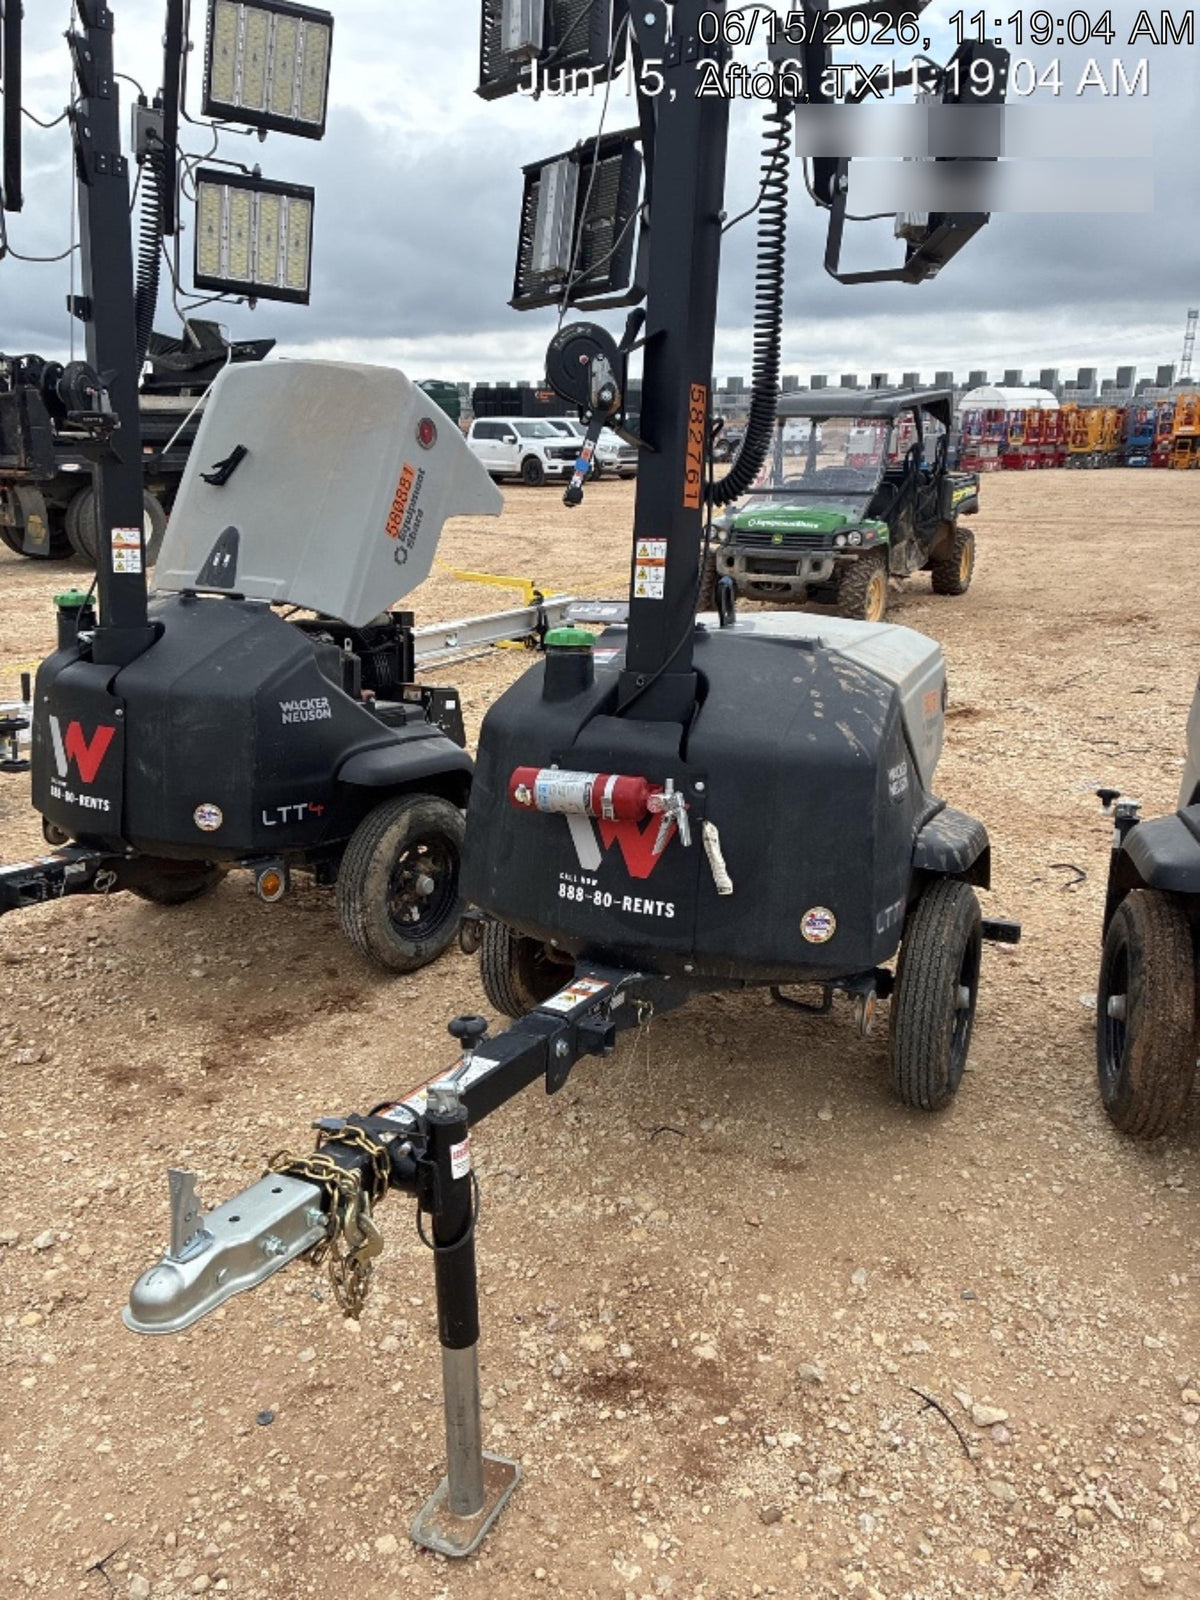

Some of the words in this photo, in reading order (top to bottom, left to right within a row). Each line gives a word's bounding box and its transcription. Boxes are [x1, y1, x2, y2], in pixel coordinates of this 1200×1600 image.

[685, 386, 705, 499] 582761
[279, 697, 329, 712] WACKER
[281, 708, 332, 724] NEUSON
[262, 802, 324, 826] LTT4
[558, 883, 676, 918] 888-80-RENTS
